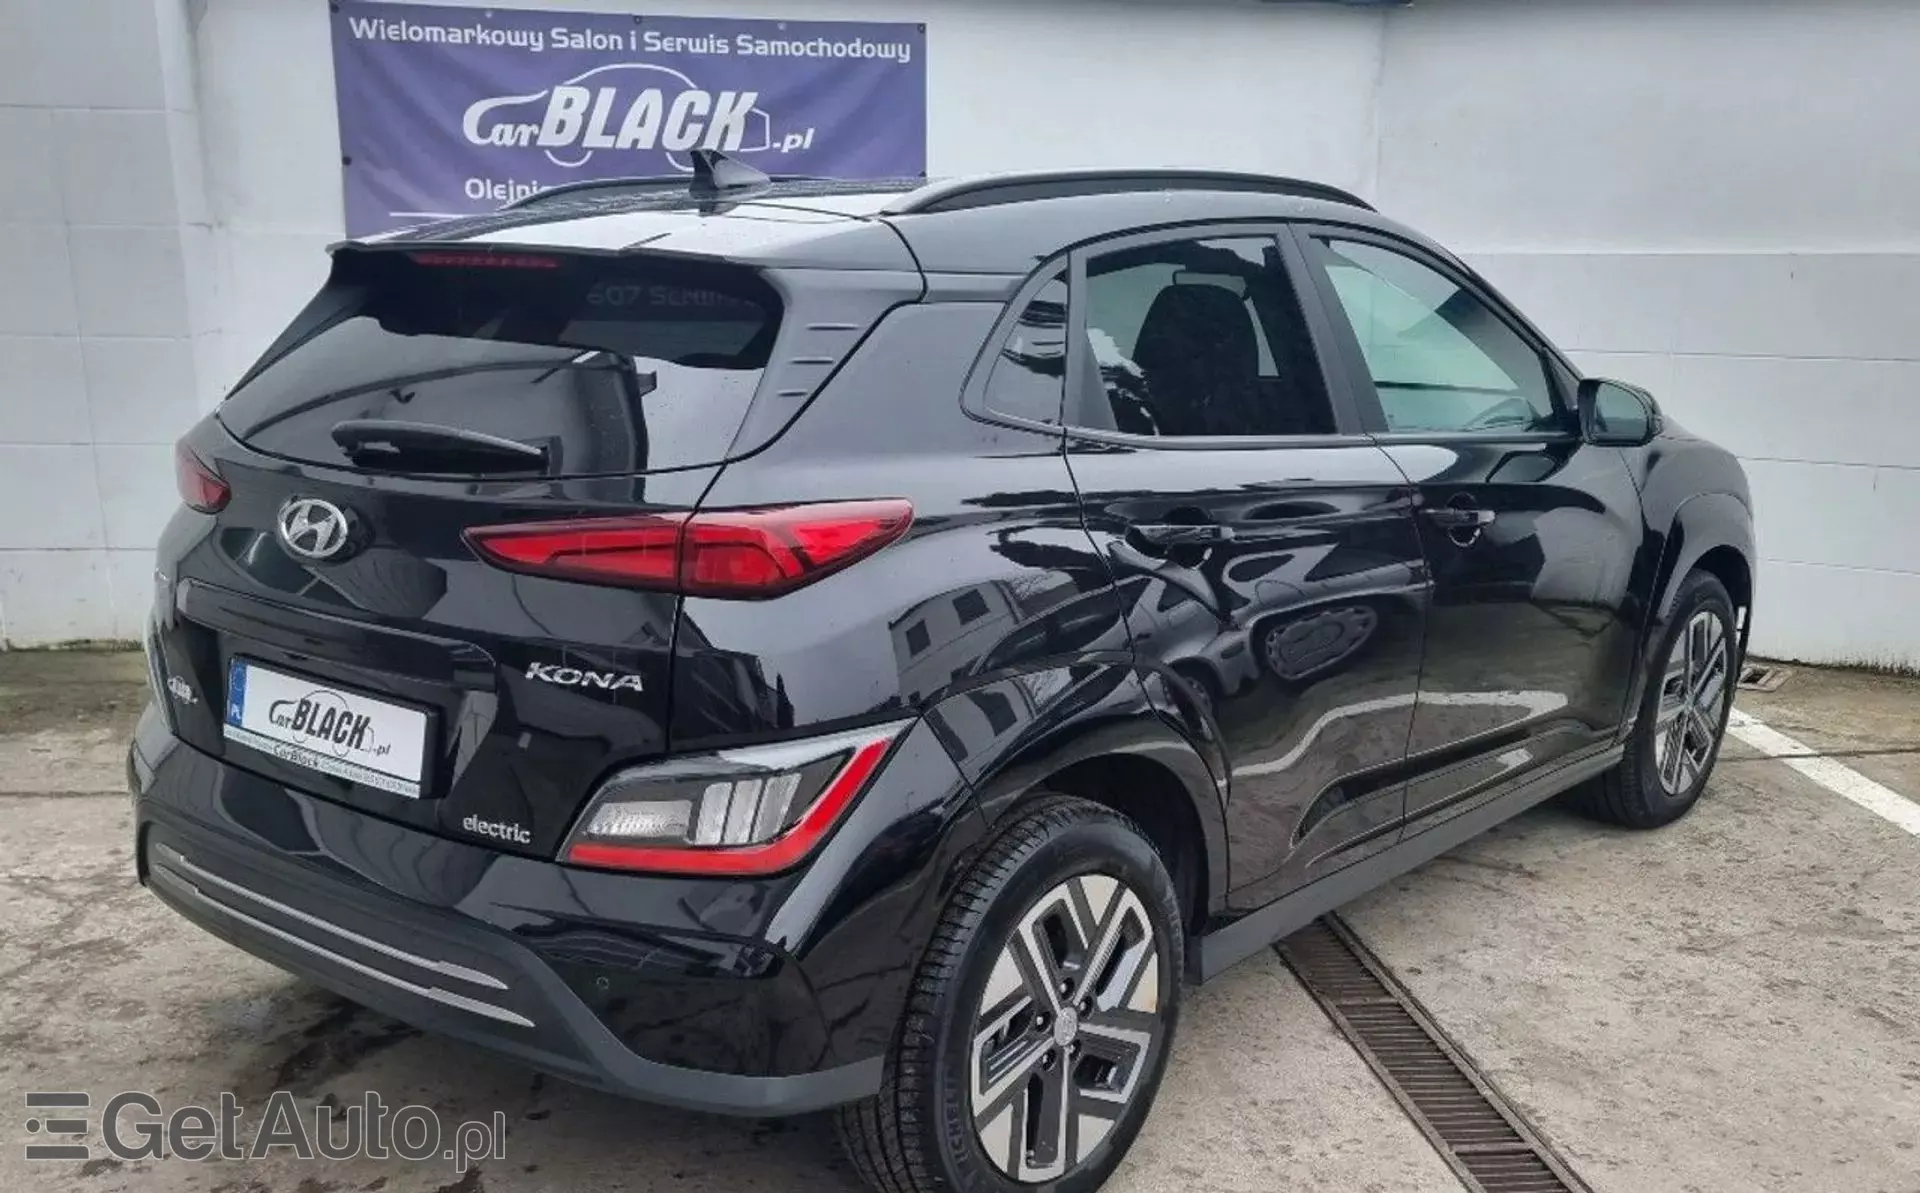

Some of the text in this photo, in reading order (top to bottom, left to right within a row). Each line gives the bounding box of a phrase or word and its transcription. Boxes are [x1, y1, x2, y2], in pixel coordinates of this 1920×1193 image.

[349, 16, 911, 63] Wielomarkowy Salon i Serwis Samochodowy
[525, 661, 644, 692] KONA
[462, 813, 532, 844] electric
